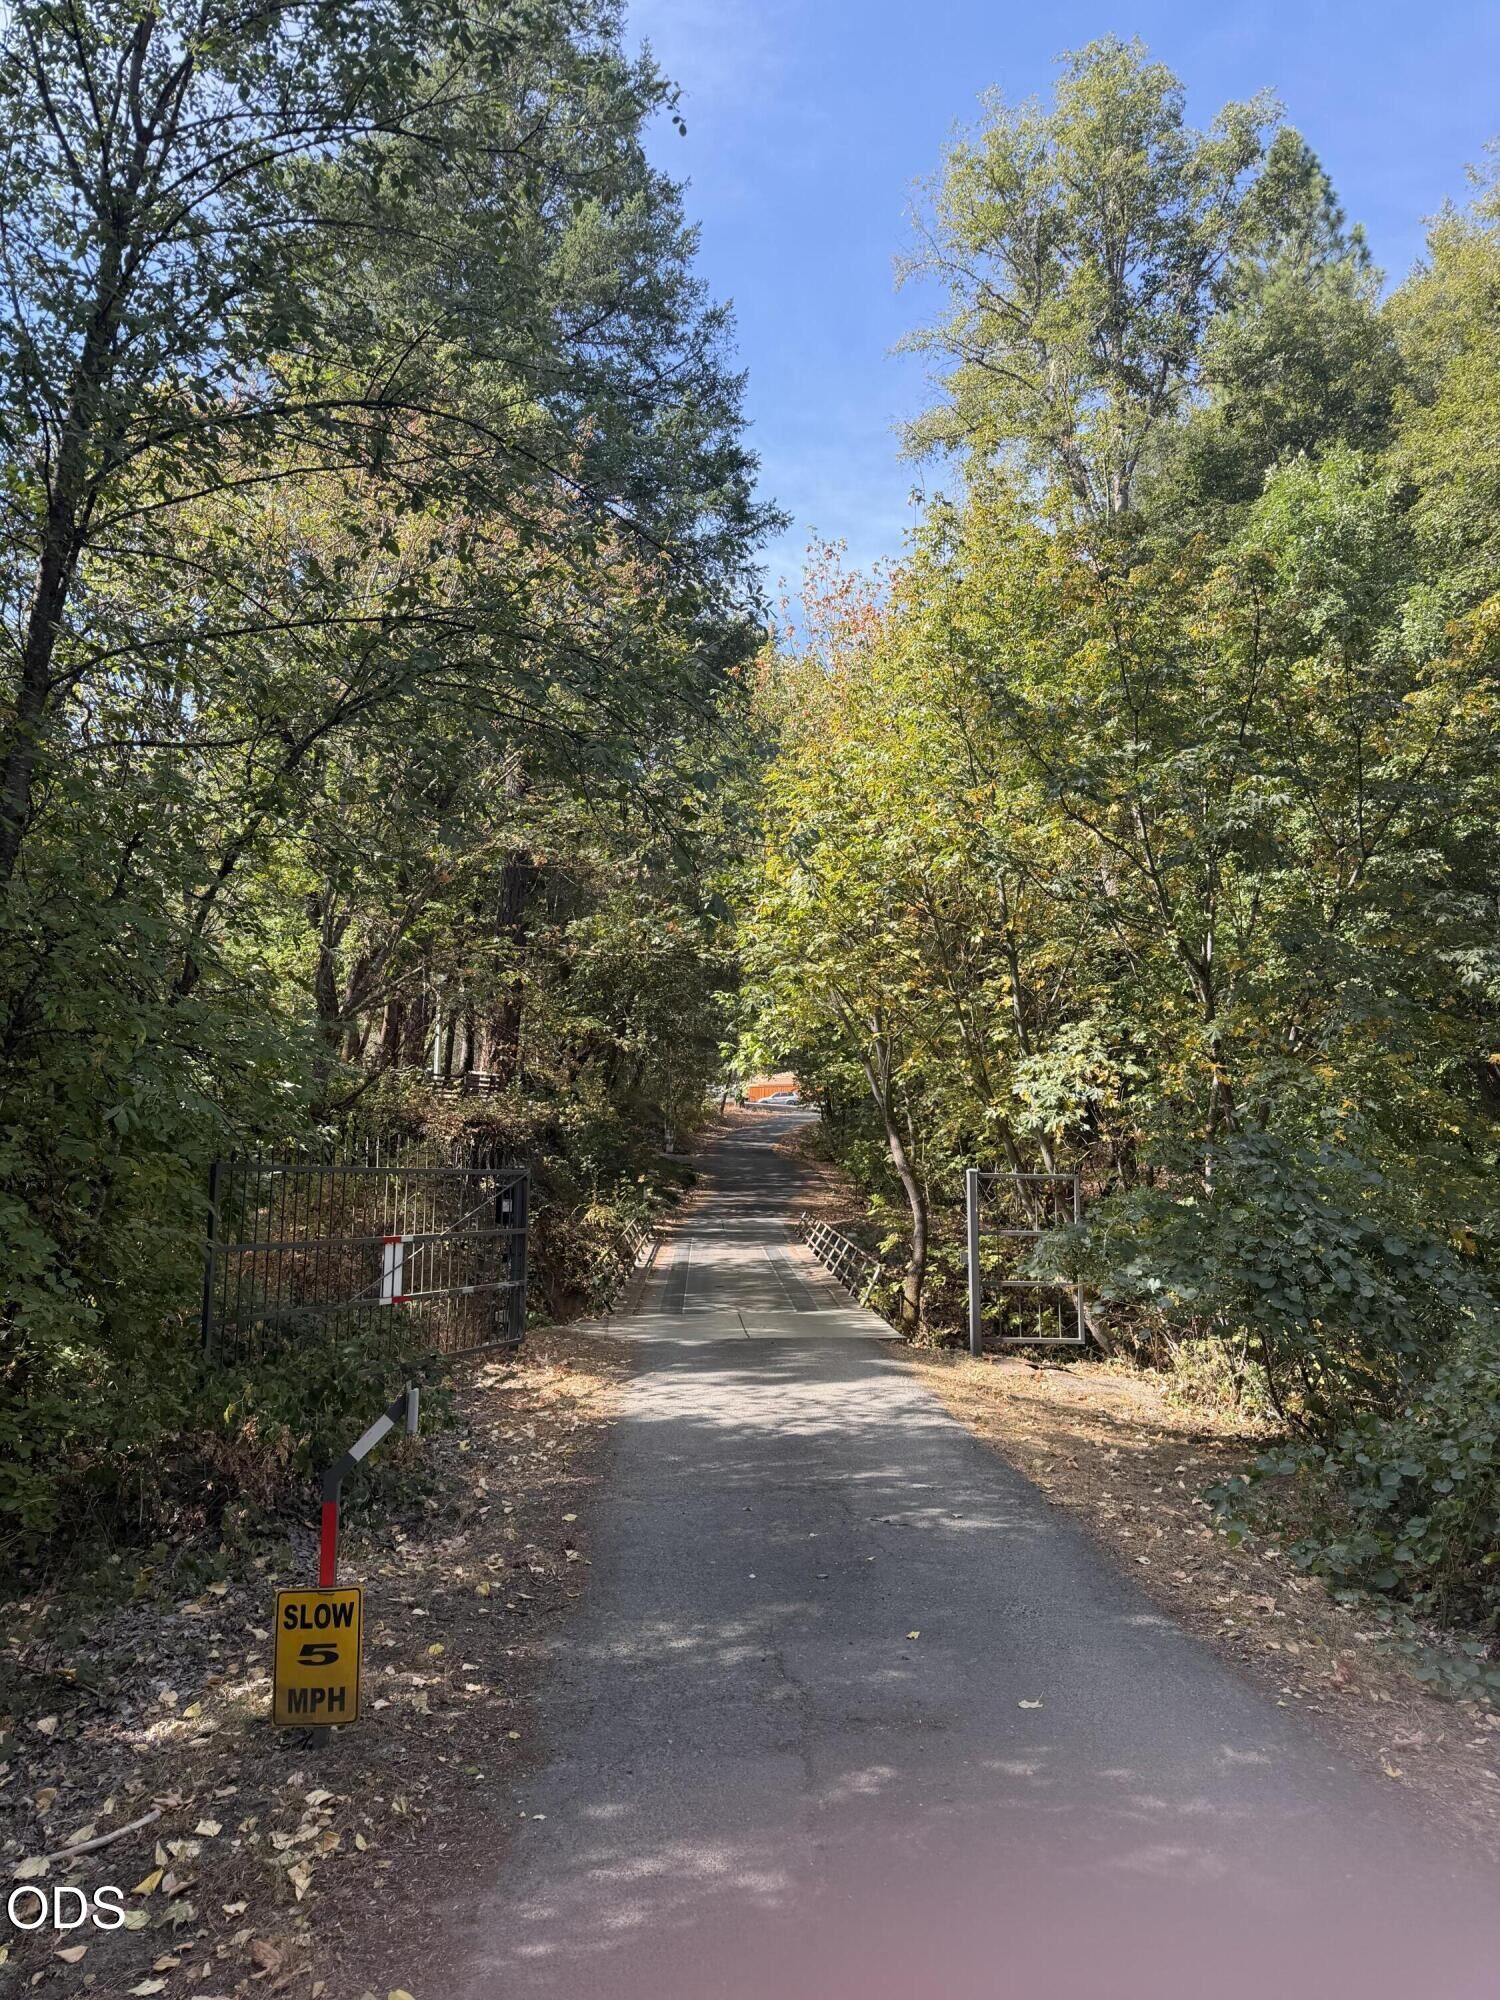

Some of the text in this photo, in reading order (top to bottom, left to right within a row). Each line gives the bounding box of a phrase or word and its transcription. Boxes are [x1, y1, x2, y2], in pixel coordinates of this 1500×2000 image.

[283, 1601, 354, 1630] SLOW
[297, 1643, 340, 1666] 5
[287, 1686, 346, 1714] MPH
